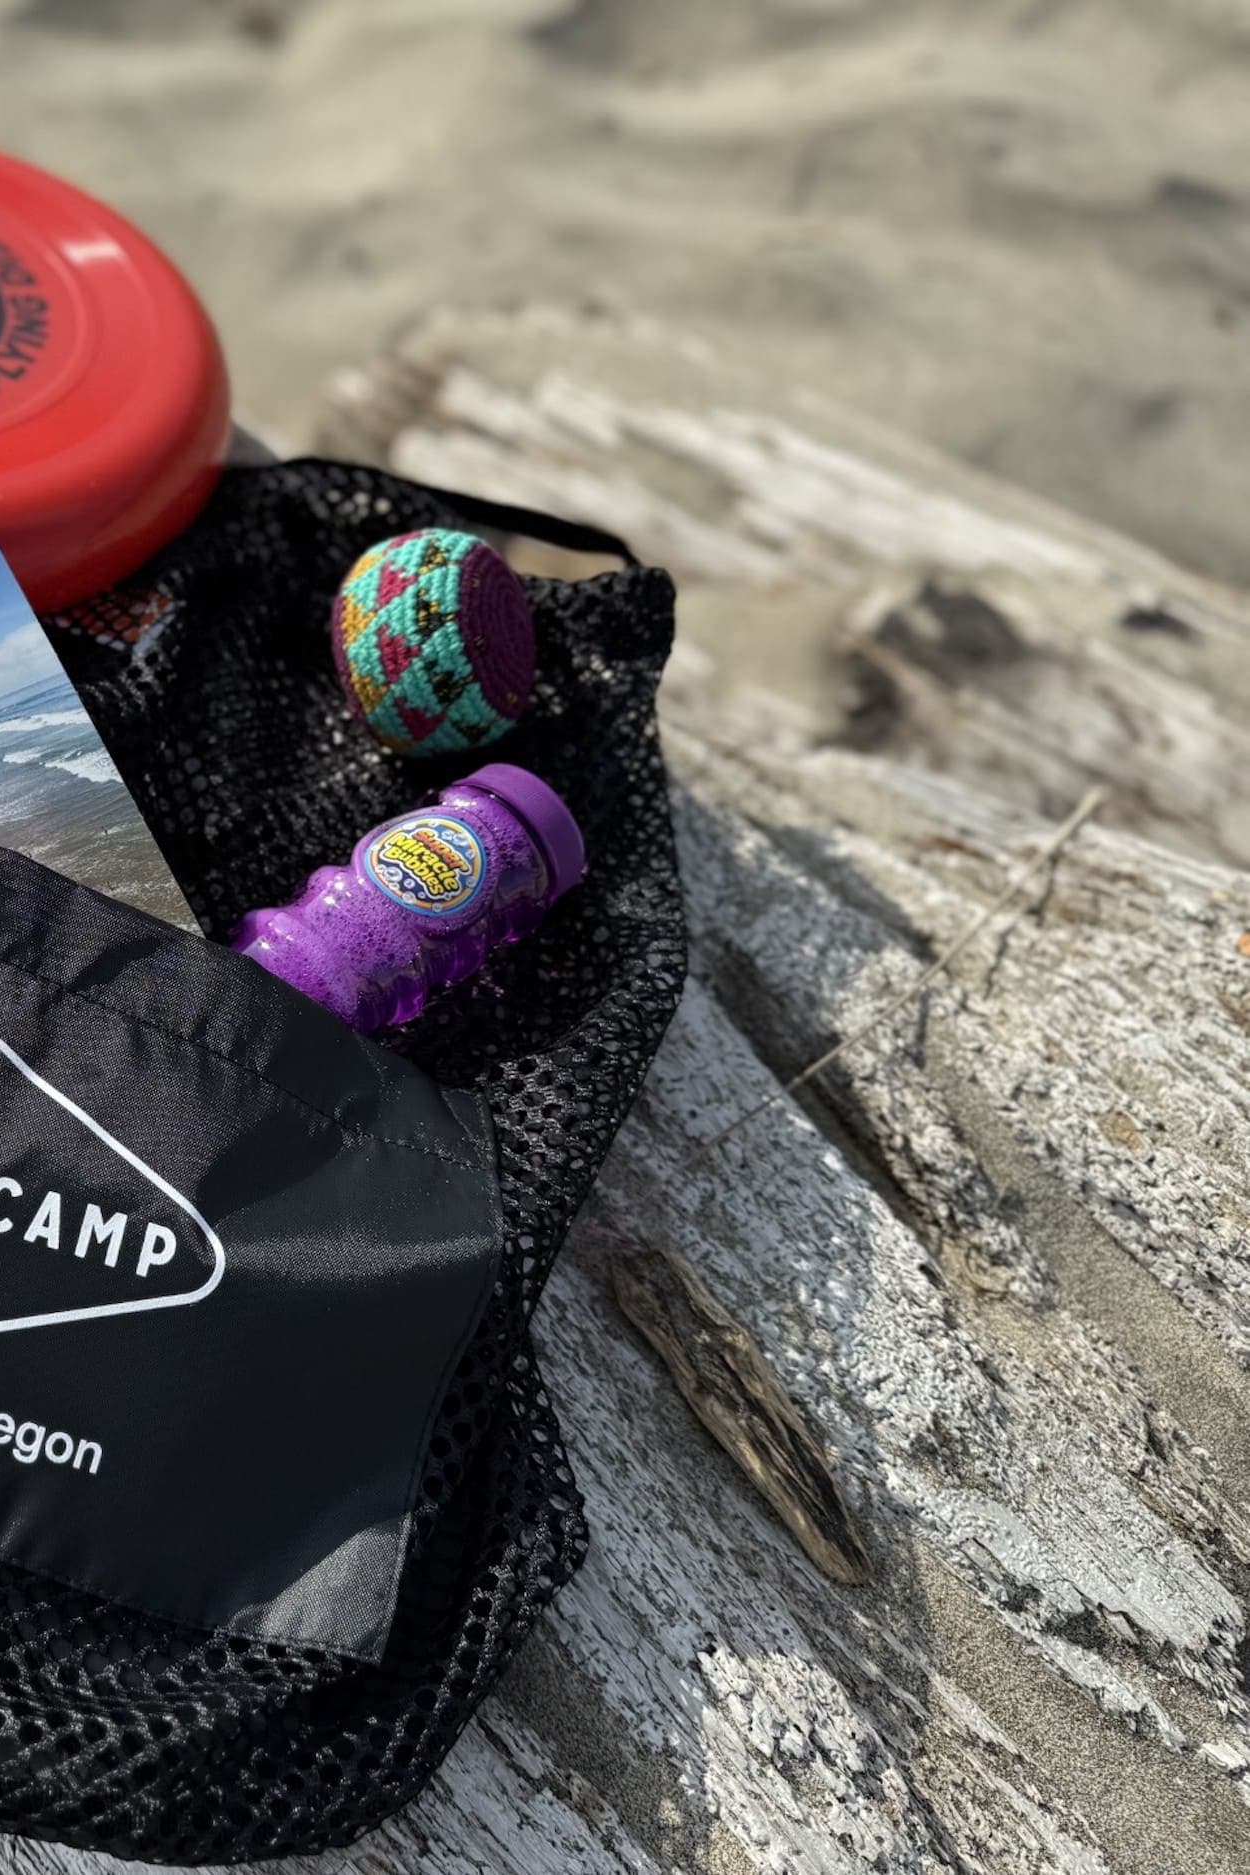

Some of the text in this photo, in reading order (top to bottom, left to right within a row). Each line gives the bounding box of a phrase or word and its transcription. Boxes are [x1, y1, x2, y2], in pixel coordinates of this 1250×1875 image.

[383, 845, 445, 896] Bubbles
[387, 832, 459, 891] Miracle
[411, 829, 470, 874] Super
